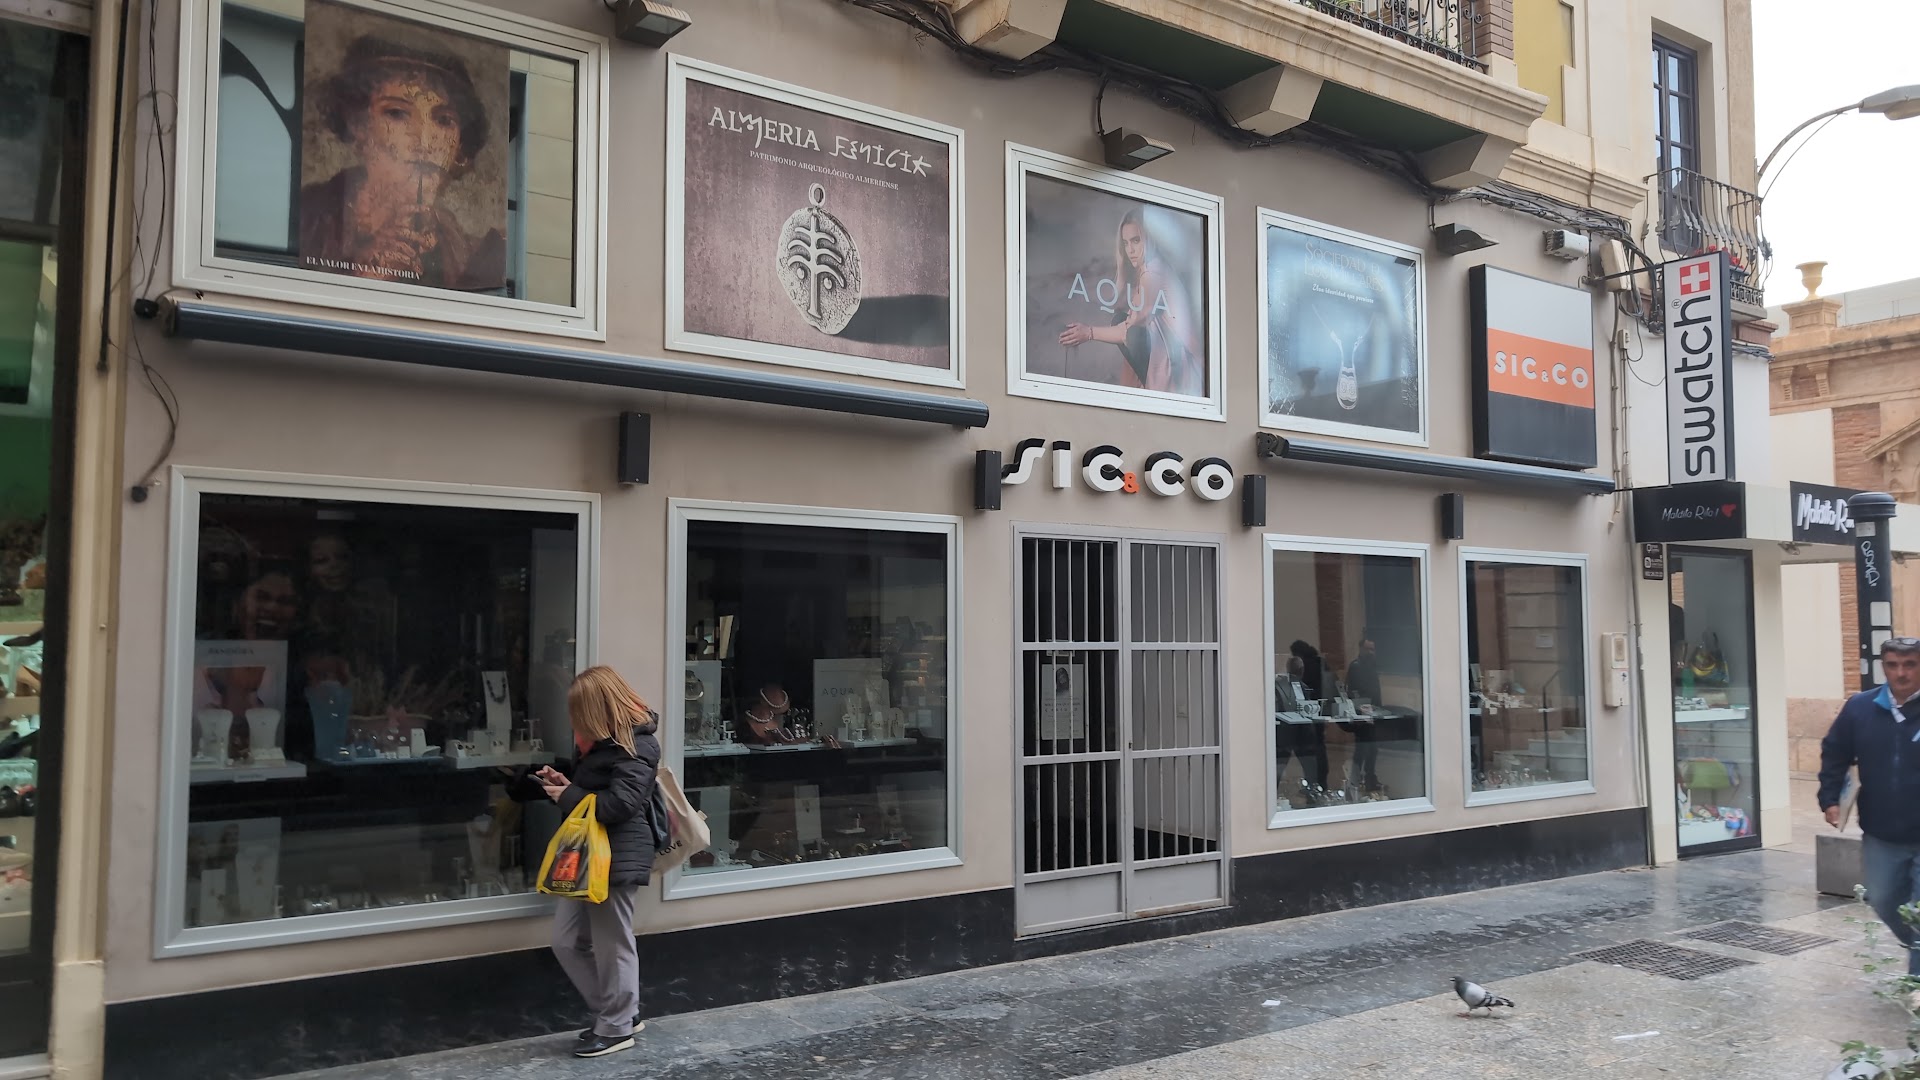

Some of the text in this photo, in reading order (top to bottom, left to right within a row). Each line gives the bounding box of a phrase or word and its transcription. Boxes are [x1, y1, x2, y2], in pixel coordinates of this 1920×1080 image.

[708, 106, 820, 152] ALMERIA
[750, 151, 899, 191] PATRIMONIO ARQUEOLÓGICO ALMERIENSE
[306, 256, 420, 280] EL VALOR EN LA HISTORIA
[1305, 241, 1366, 273] SOCIEDAD
[1067, 273, 1172, 315] AQUA
[659, 840, 683, 856] LOVE
